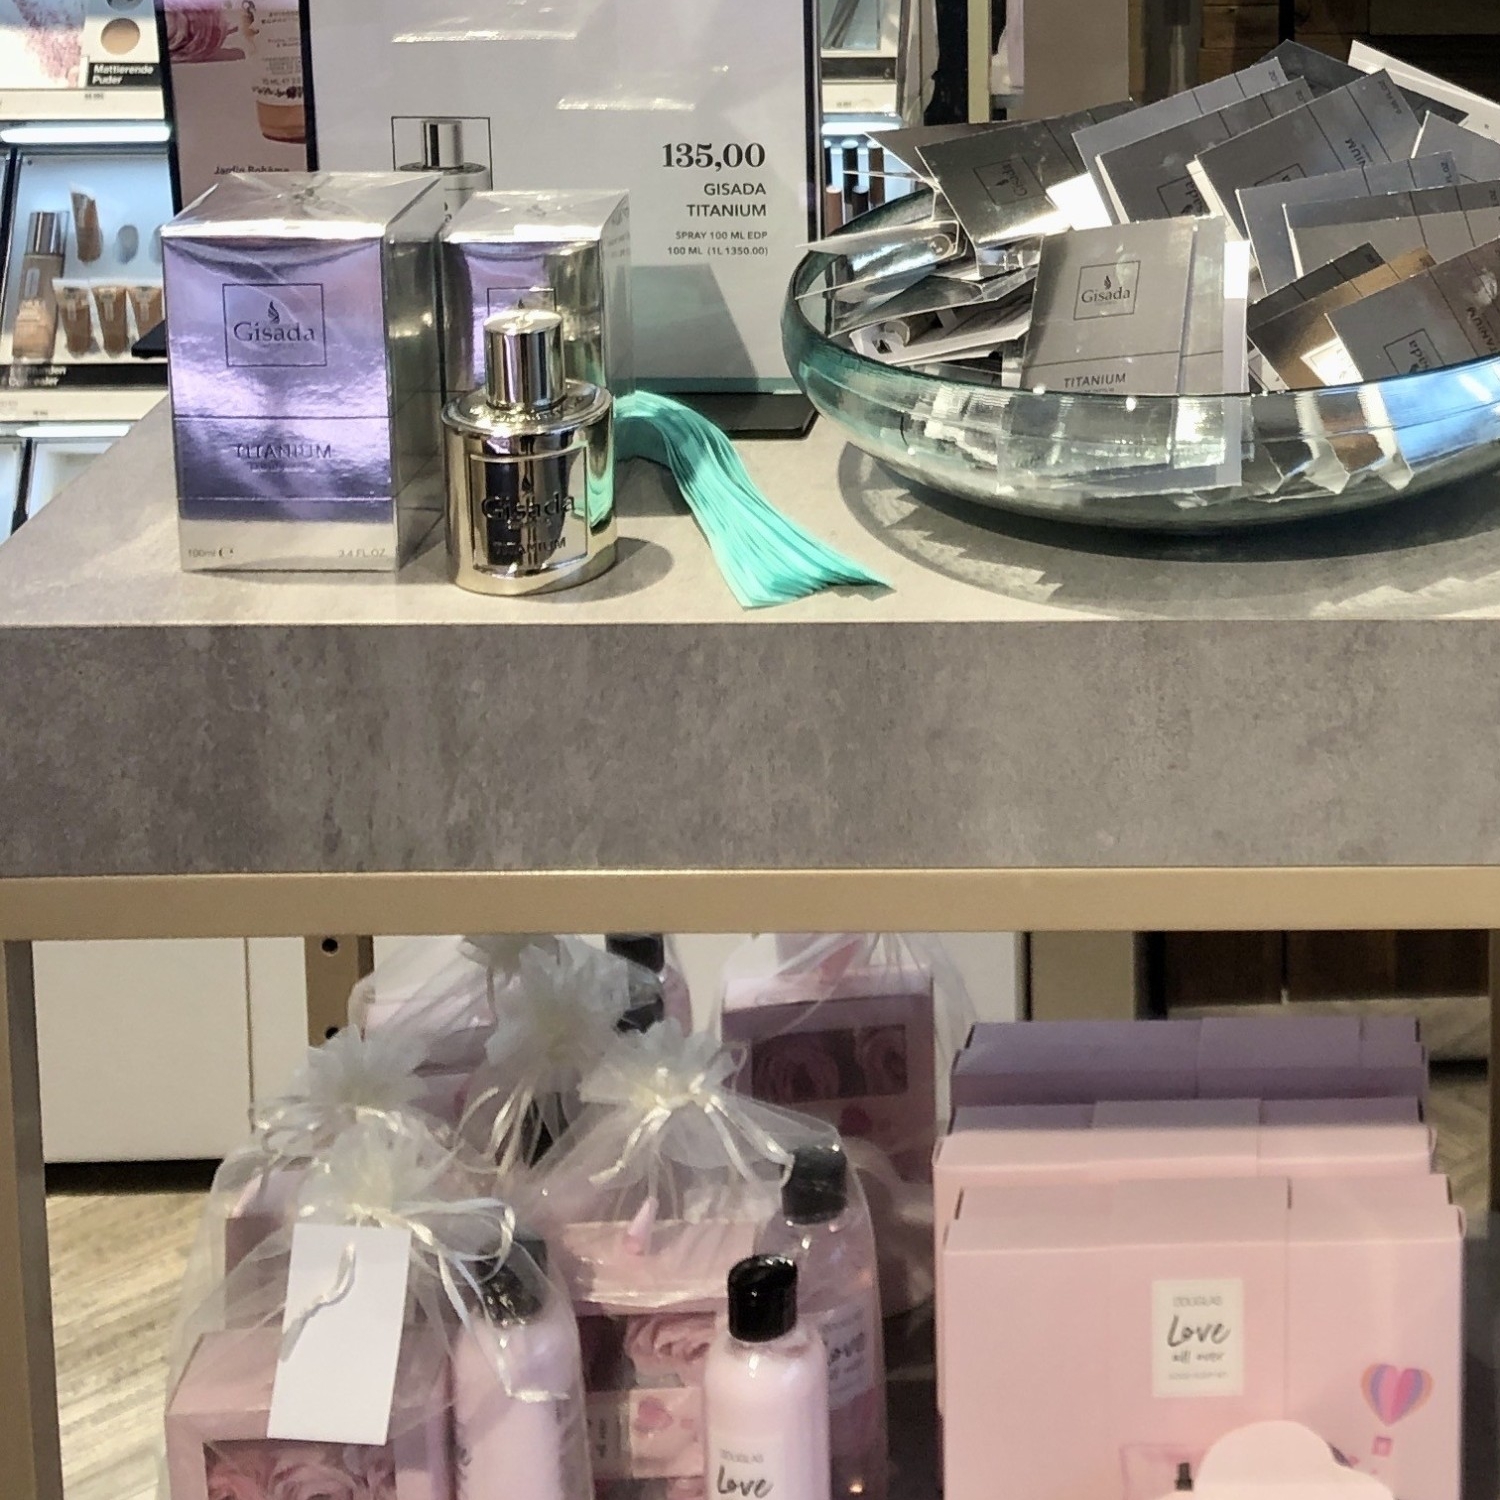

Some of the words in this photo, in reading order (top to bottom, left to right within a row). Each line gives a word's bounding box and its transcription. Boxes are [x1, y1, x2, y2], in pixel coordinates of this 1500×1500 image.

[93, 64, 154, 75] Mattierende
[92, 75, 123, 85] Puder
[662, 143, 765, 172] 135,00
[704, 183, 767, 196] GISADA
[686, 204, 767, 217] TITANIUM
[675, 231, 706, 240] SPRAY
[710, 231, 727, 240] 100
[730, 231, 744, 240] ML
[747, 231, 768, 239] EDP
[667, 247, 685, 255] 100
[688, 247, 702, 255] ML
[707, 247, 722, 256] (1L
[1081, 286, 1131, 304] Gisada
[233, 321, 315, 342] Gisada
[1064, 373, 1126, 389] TITANIUM
[235, 443, 331, 459] TITANIUM
[481, 491, 575, 520] Gisada
[1167, 1315, 1231, 1347] Love
[717, 1465, 774, 1498] Love
